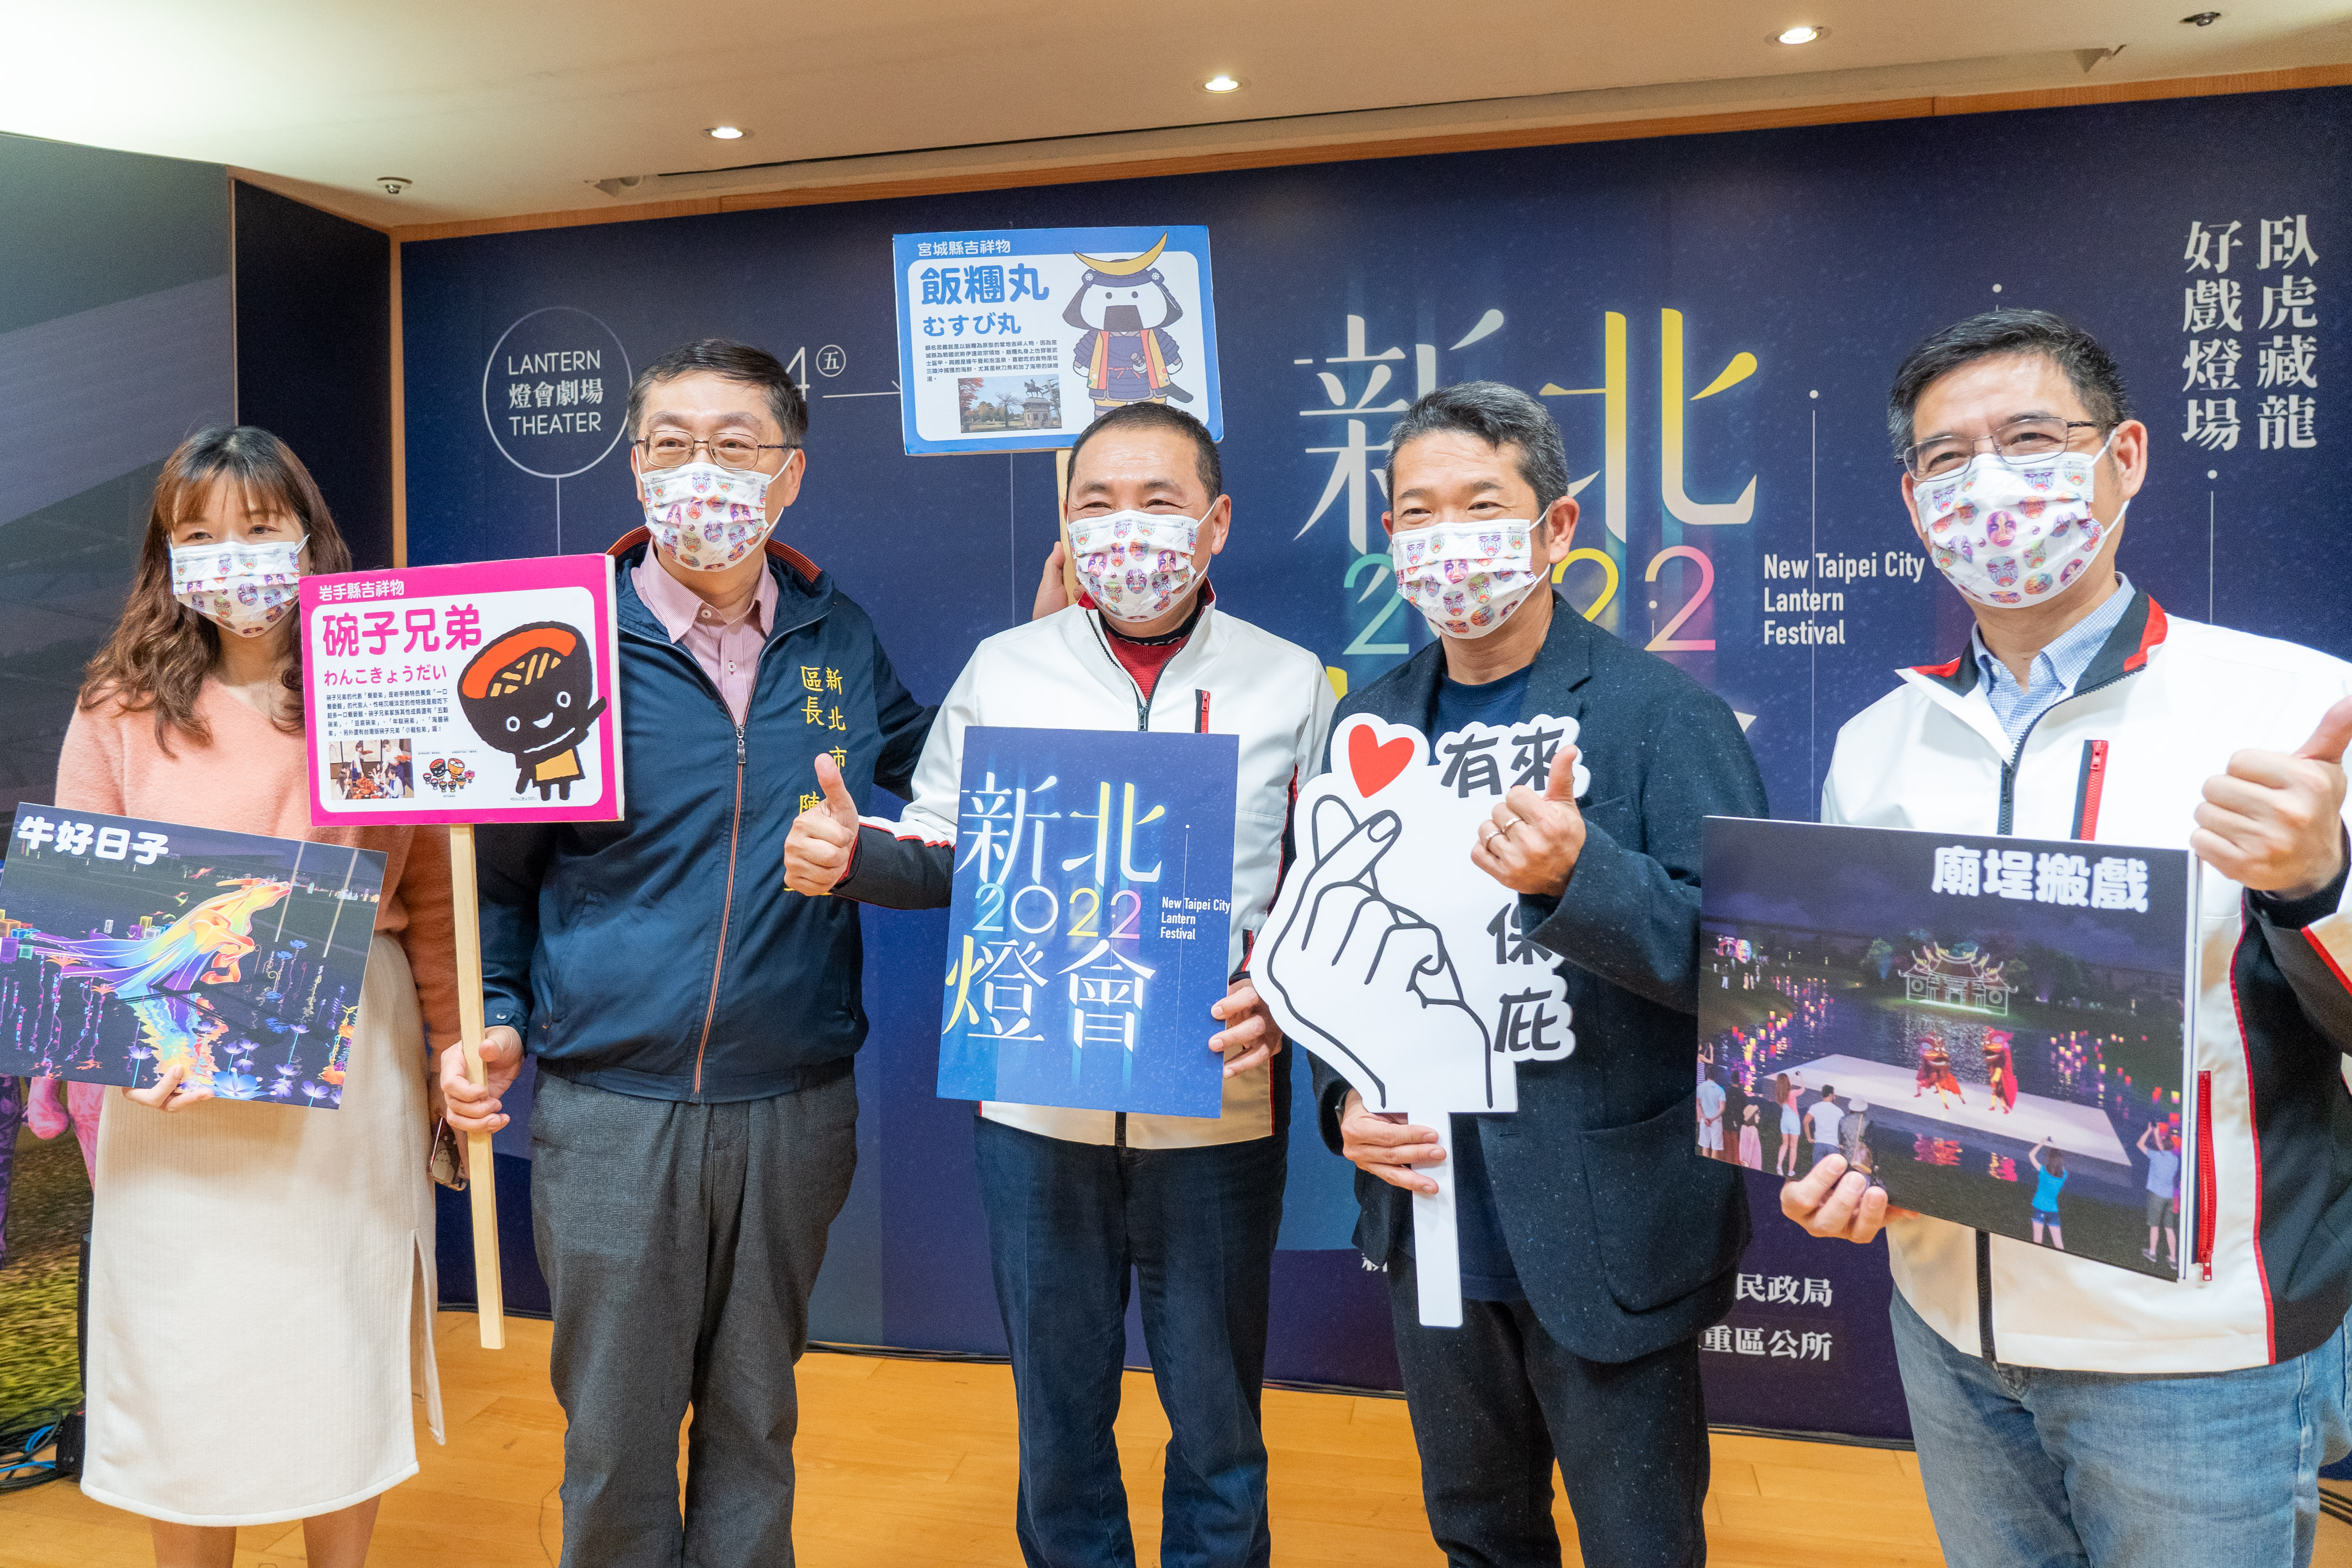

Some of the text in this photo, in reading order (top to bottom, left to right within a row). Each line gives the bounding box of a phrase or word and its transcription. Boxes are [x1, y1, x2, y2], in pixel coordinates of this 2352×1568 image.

[917, 239, 1011, 257] 宮城縣吉祥物
[920, 263, 1050, 305] 飯糰丸
[923, 311, 1022, 336] むすび丸
[2181, 219, 2243, 451] 好戲燈場
[2256, 214, 2319, 450] 臥虎藏龍
[508, 349, 601, 375] LANTERN
[508, 378, 604, 410] 燈會劇場
[508, 411, 602, 436] THEATER
[1763, 551, 1925, 584] New Taipei City
[319, 579, 405, 602] 岩手縣吉祥物
[1763, 586, 1844, 613] Lantern
[322, 603, 482, 657] 碗子兄弟
[1763, 618, 1846, 645] Festival
[324, 664, 447, 686] わんこきょうだい
[800, 665, 825, 726] 區長
[17, 815, 170, 866] 牛好日子
[954, 771, 1166, 890] 新北
[1931, 844, 2150, 913] 廟埕搬戲
[972, 882, 1142, 940] 2022
[1160, 911, 1196, 925] Lantern
[1161, 896, 1231, 913] New Taipei City
[1160, 926, 1196, 940] Festival
[942, 934, 1156, 1052] 燈會
[1735, 1272, 1833, 1308] 民政局
[1698, 1324, 1832, 1361] 重區公所
